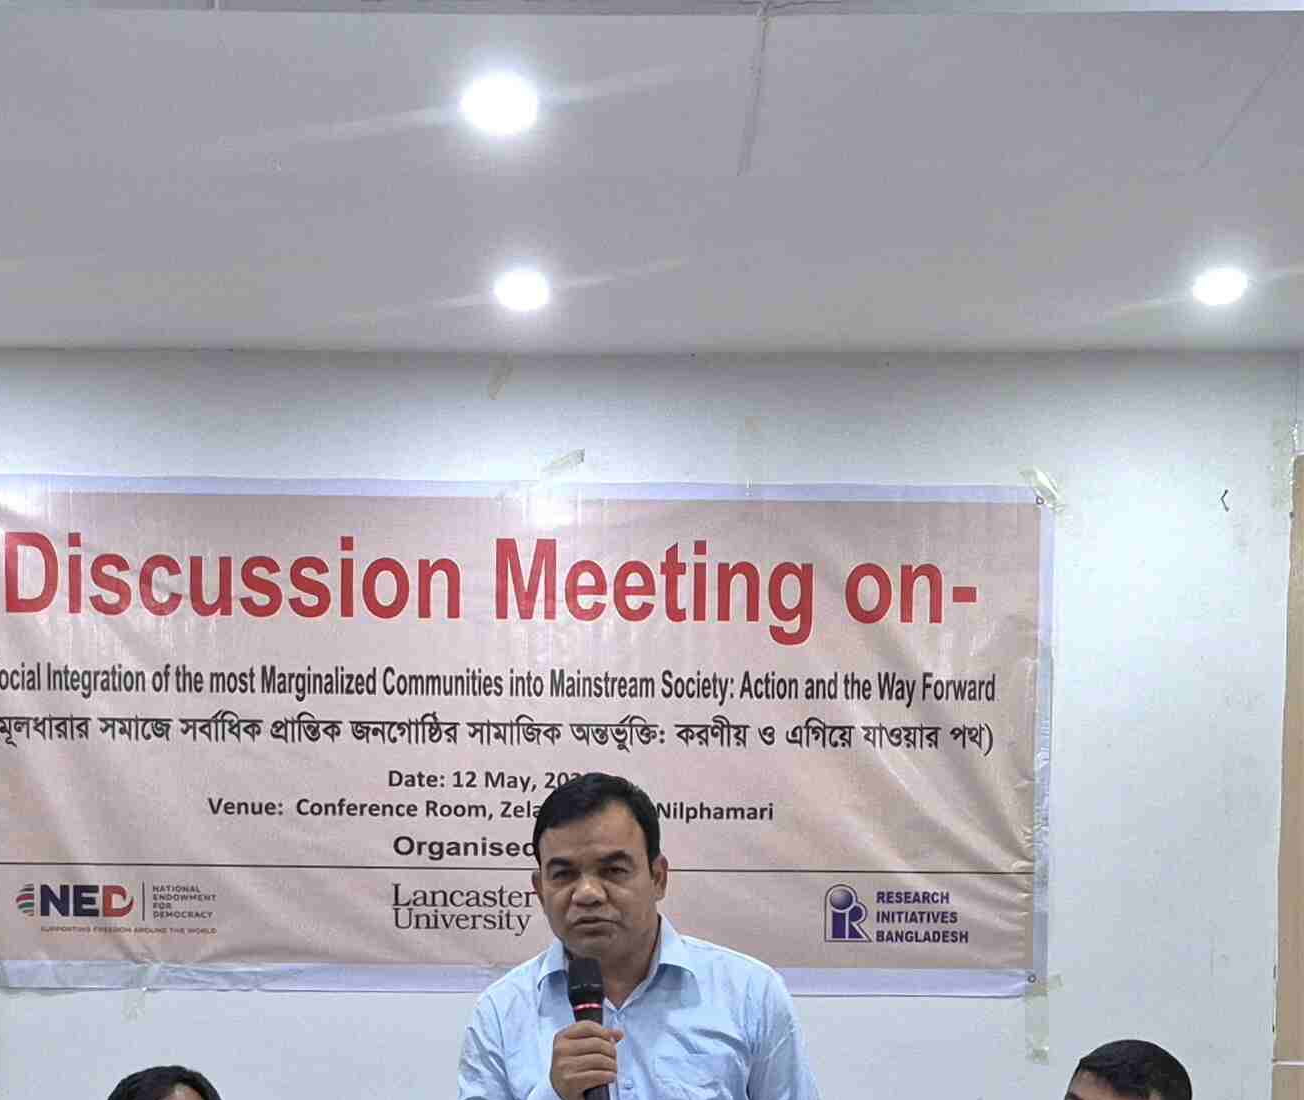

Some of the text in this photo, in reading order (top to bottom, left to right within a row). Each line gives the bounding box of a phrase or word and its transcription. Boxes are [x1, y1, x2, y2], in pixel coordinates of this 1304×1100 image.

[2, 530, 979, 648] Discussion Meeting on-
[47, 662, 146, 699] Integration
[151, 664, 171, 693] of
[175, 664, 204, 693] the
[209, 665, 256, 694] most
[261, 665, 377, 701] Marginalized
[382, 666, 504, 697] Communities
[509, 668, 544, 697] into
[550, 668, 655, 698] Mainstream
[660, 670, 735, 706] Society:
[740, 671, 799, 699] Action
[804, 671, 838, 700] and
[843, 671, 872, 700] the
[878, 671, 916, 708] Way
[922, 672, 996, 701] Forward
[96, 714, 173, 742] সমাজে
[178, 709, 264, 744] সর্বাধিক
[269, 711, 343, 745] প্রান্তিক
[466, 714, 563, 746] সামাজিক
[674, 715, 751, 749] করণীয়
[758, 726, 776, 746] ও
[785, 716, 856, 749] এগিয়ে
[860, 722, 942, 749] যাওয়ার
[949, 722, 995, 757] পথ)
[387, 770, 446, 789] Date:
[452, 771, 477, 788] 12
[484, 771, 538, 792] May,
[208, 798, 284, 816] Venue:
[296, 799, 419, 818] Conference
[425, 801, 494, 821] Room,
[656, 802, 774, 823] Nilphamari
[153, 885, 201, 893] NATIONAL
[392, 883, 533, 908] Lancaster
[876, 891, 950, 904] RESEARCH
[40, 884, 134, 918] NED
[153, 902, 172, 910] FOR
[153, 911, 213, 919] DEMOCRACY
[393, 908, 532, 937] University
[876, 911, 958, 924] INITIATIVES
[876, 930, 969, 943] BANGLADESH
